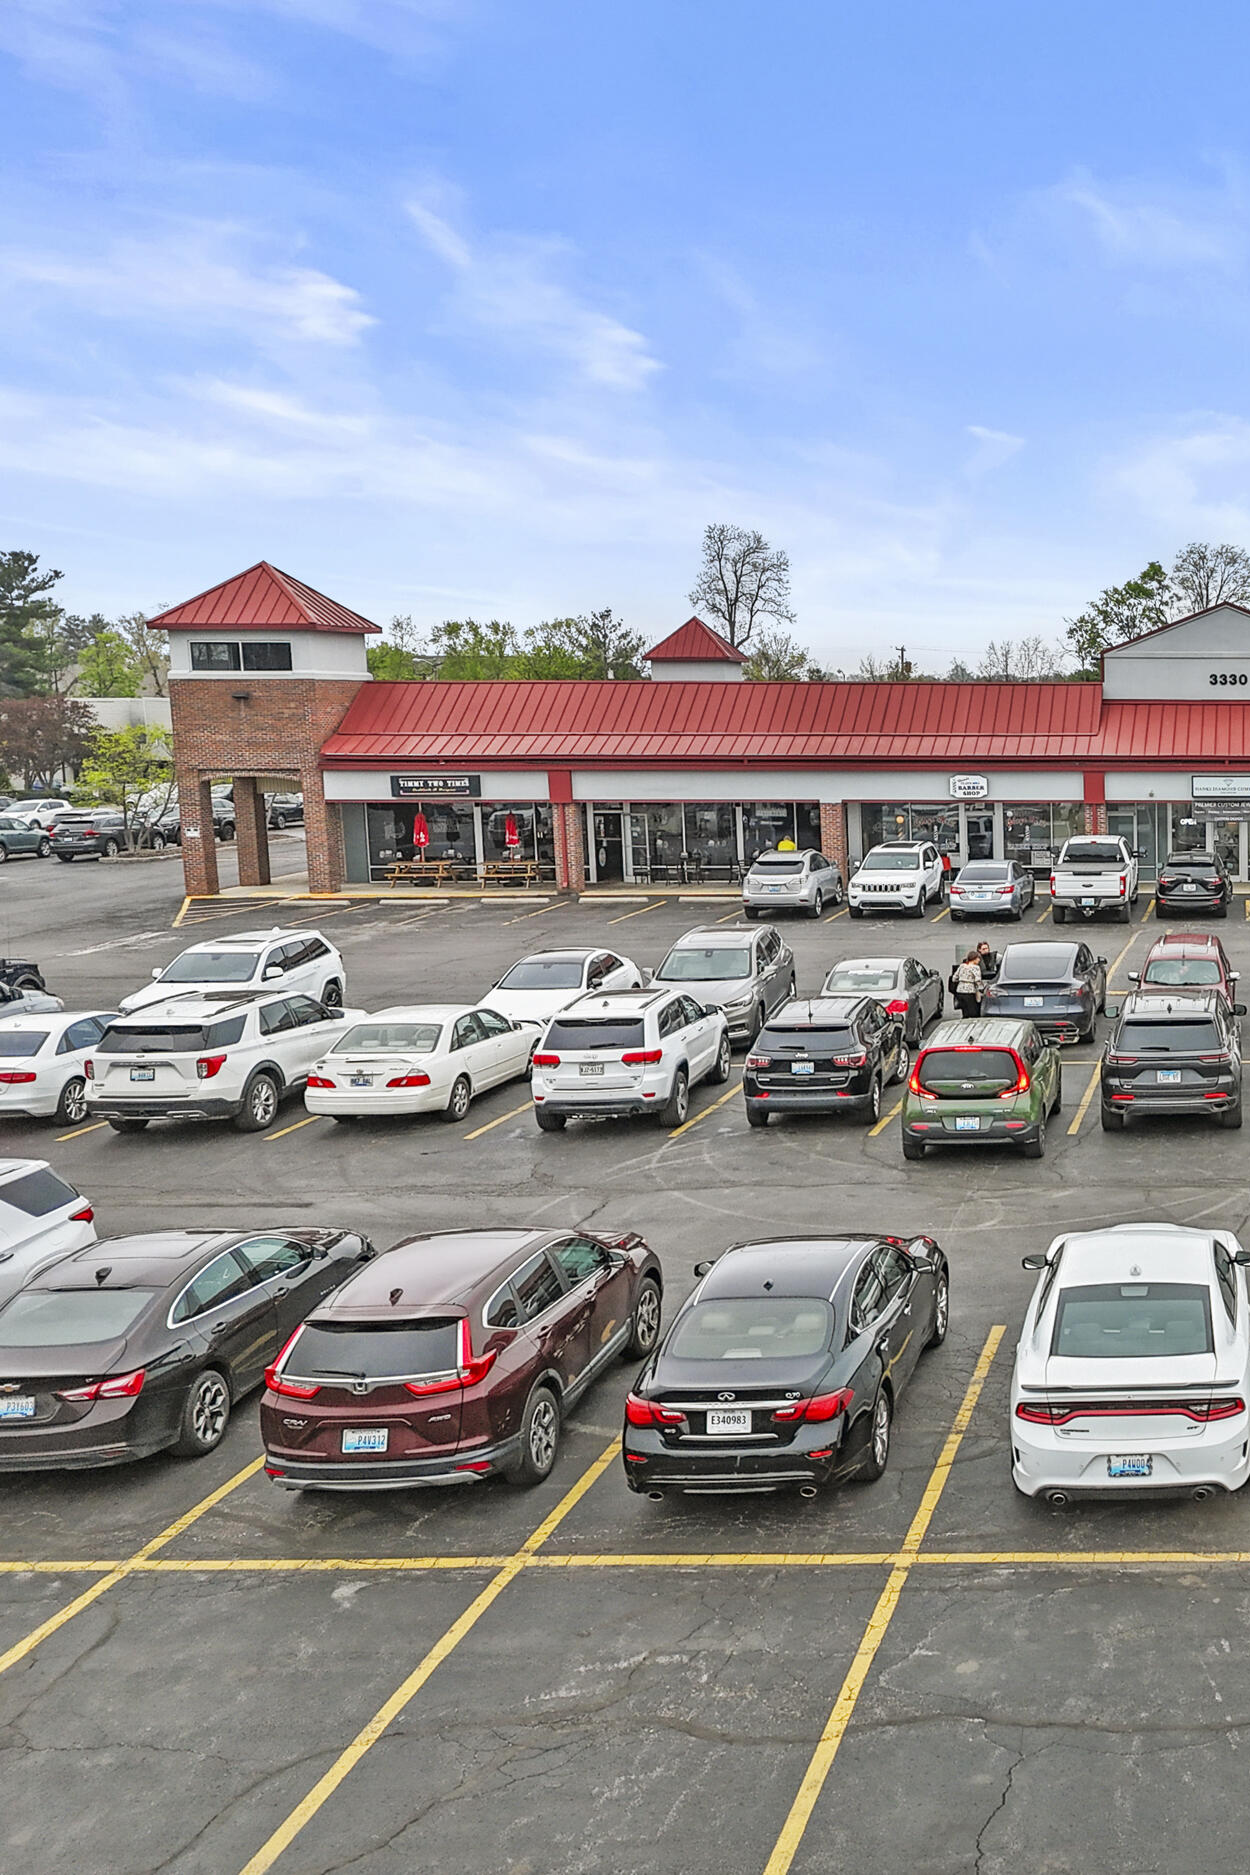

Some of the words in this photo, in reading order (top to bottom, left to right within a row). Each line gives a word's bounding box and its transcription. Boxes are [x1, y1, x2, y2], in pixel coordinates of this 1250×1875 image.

[1209, 674, 1248, 685] 3330
[785, 1391, 801, 1400] Q70
[711, 1415, 747, 1425] E340983
[357, 1434, 386, 1446] P4V312
